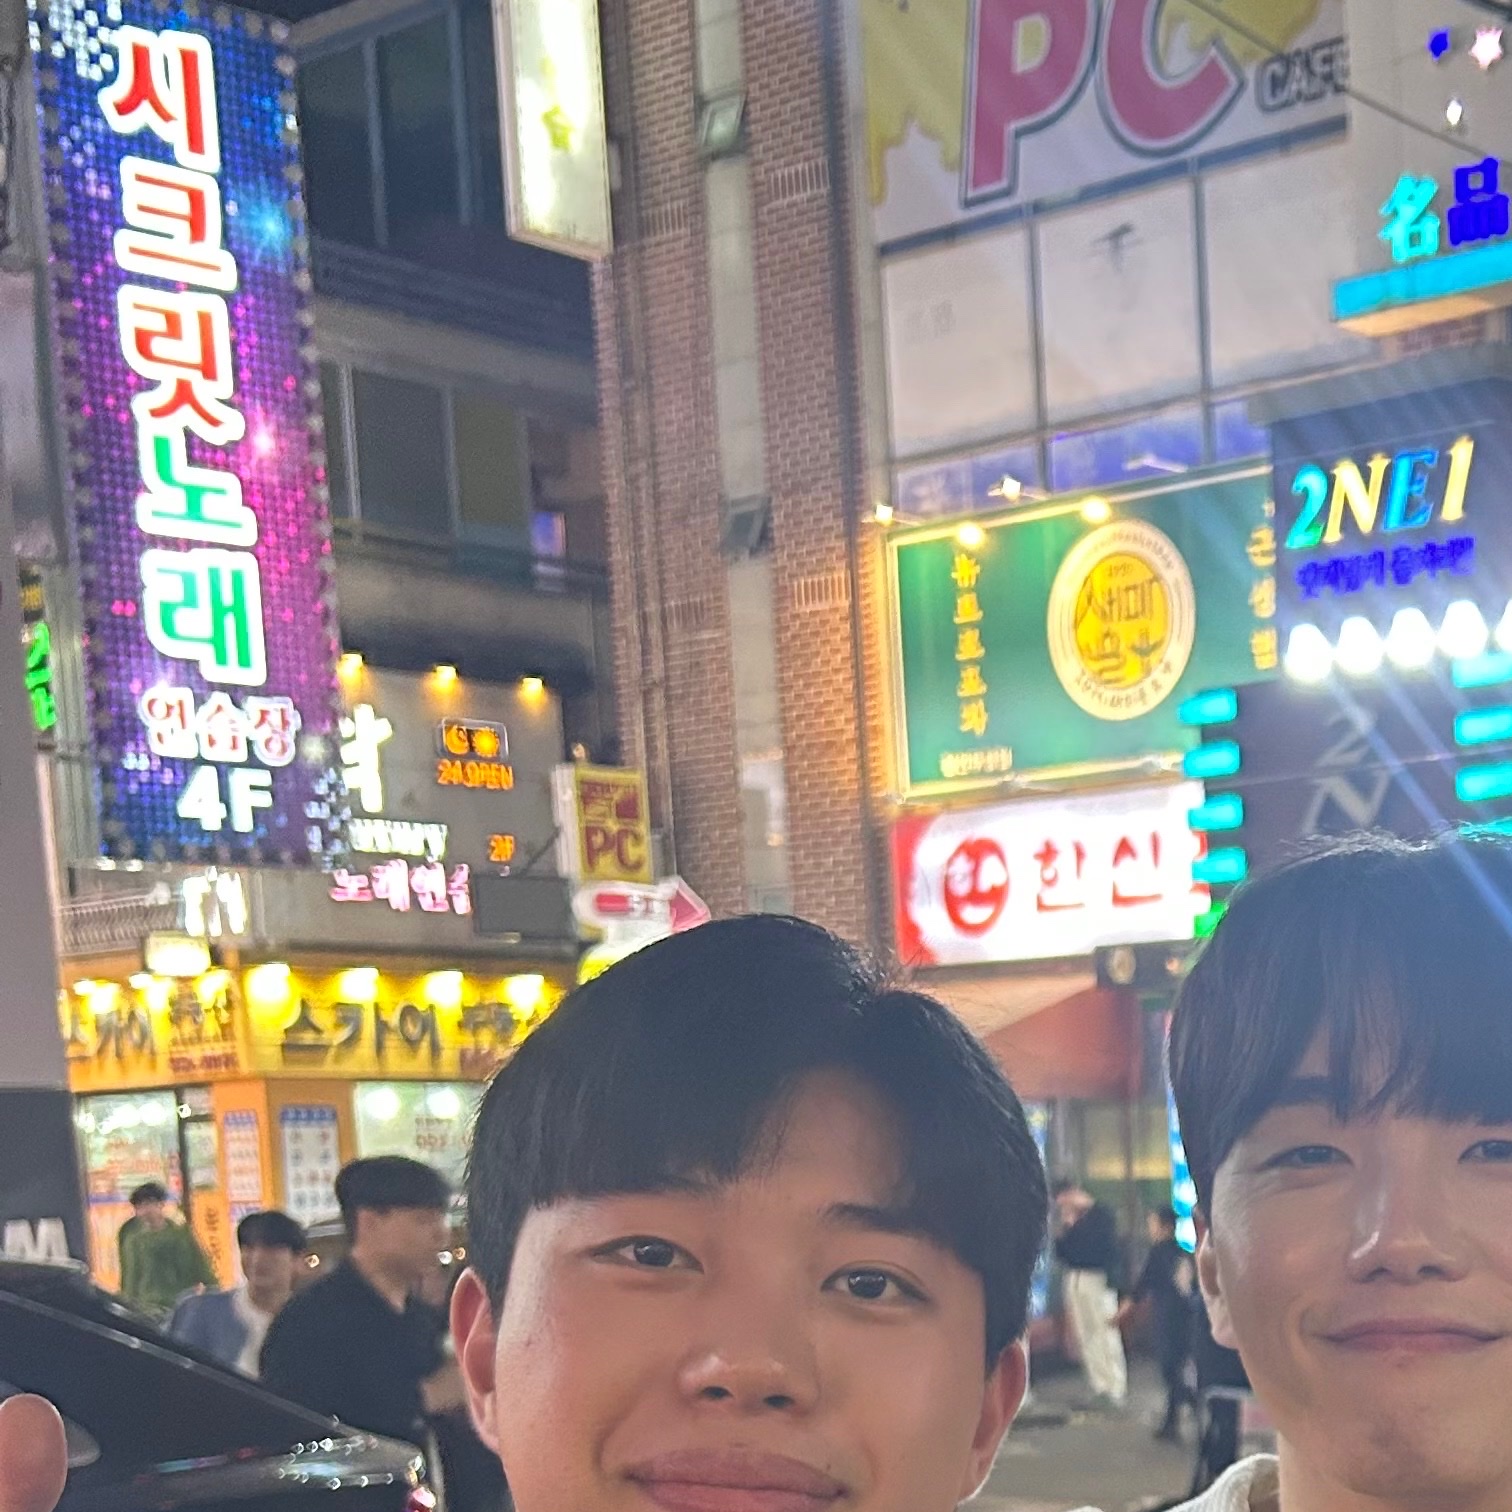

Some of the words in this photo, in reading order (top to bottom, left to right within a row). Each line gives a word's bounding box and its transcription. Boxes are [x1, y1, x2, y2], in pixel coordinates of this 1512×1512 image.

[961, 0, 1245, 207] PC
[1286, 434, 1475, 549] 2NE1
[140, 691, 298, 767] 연습장
[176, 768, 273, 832] 4F
[584, 824, 644, 872] PC
